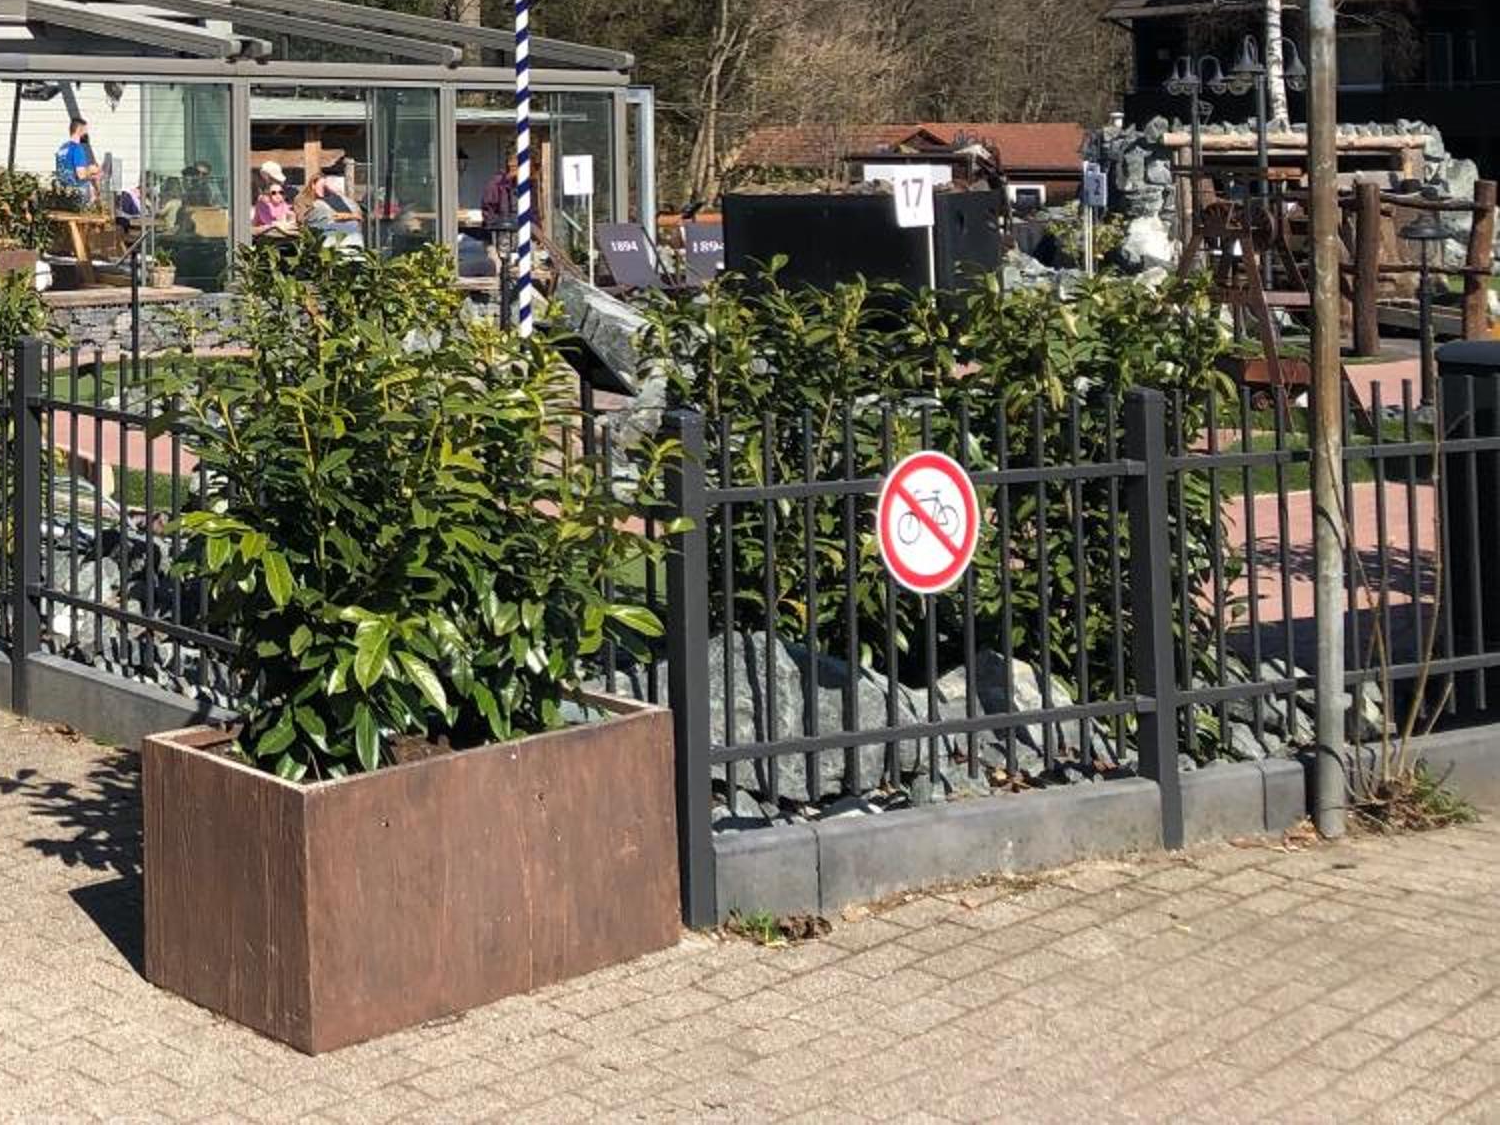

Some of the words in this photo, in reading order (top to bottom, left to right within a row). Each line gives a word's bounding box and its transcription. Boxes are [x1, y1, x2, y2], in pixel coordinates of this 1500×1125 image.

[572, 163, 581, 182] 1
[901, 178, 924, 208] 17
[610, 240, 639, 252] 1894
